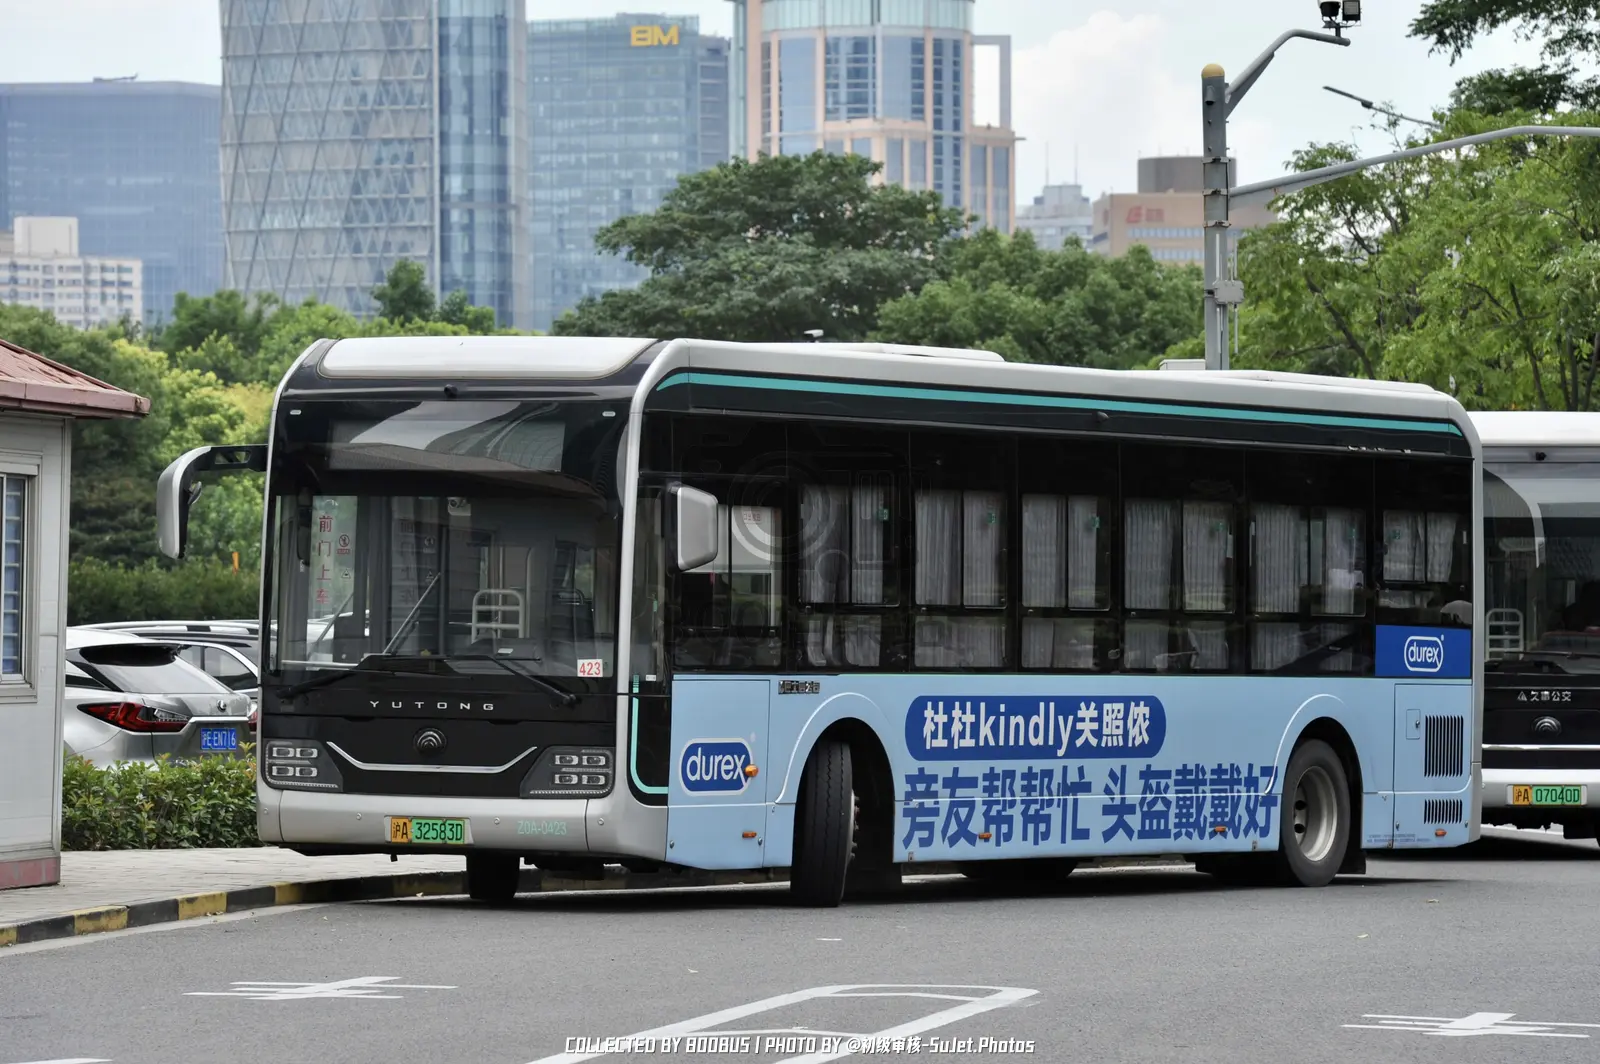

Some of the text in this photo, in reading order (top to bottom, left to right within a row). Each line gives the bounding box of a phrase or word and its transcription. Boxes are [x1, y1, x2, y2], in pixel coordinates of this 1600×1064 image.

[316, 515, 333, 604] 前门上车
[579, 662, 601, 676] 423
[1408, 641, 1440, 665] durex
[370, 700, 495, 711] YUTONG
[923, 700, 1150, 757] 杜杜kindly关照侬
[686, 747, 747, 784] durex
[1101, 762, 1279, 845] 头盔戴戴好
